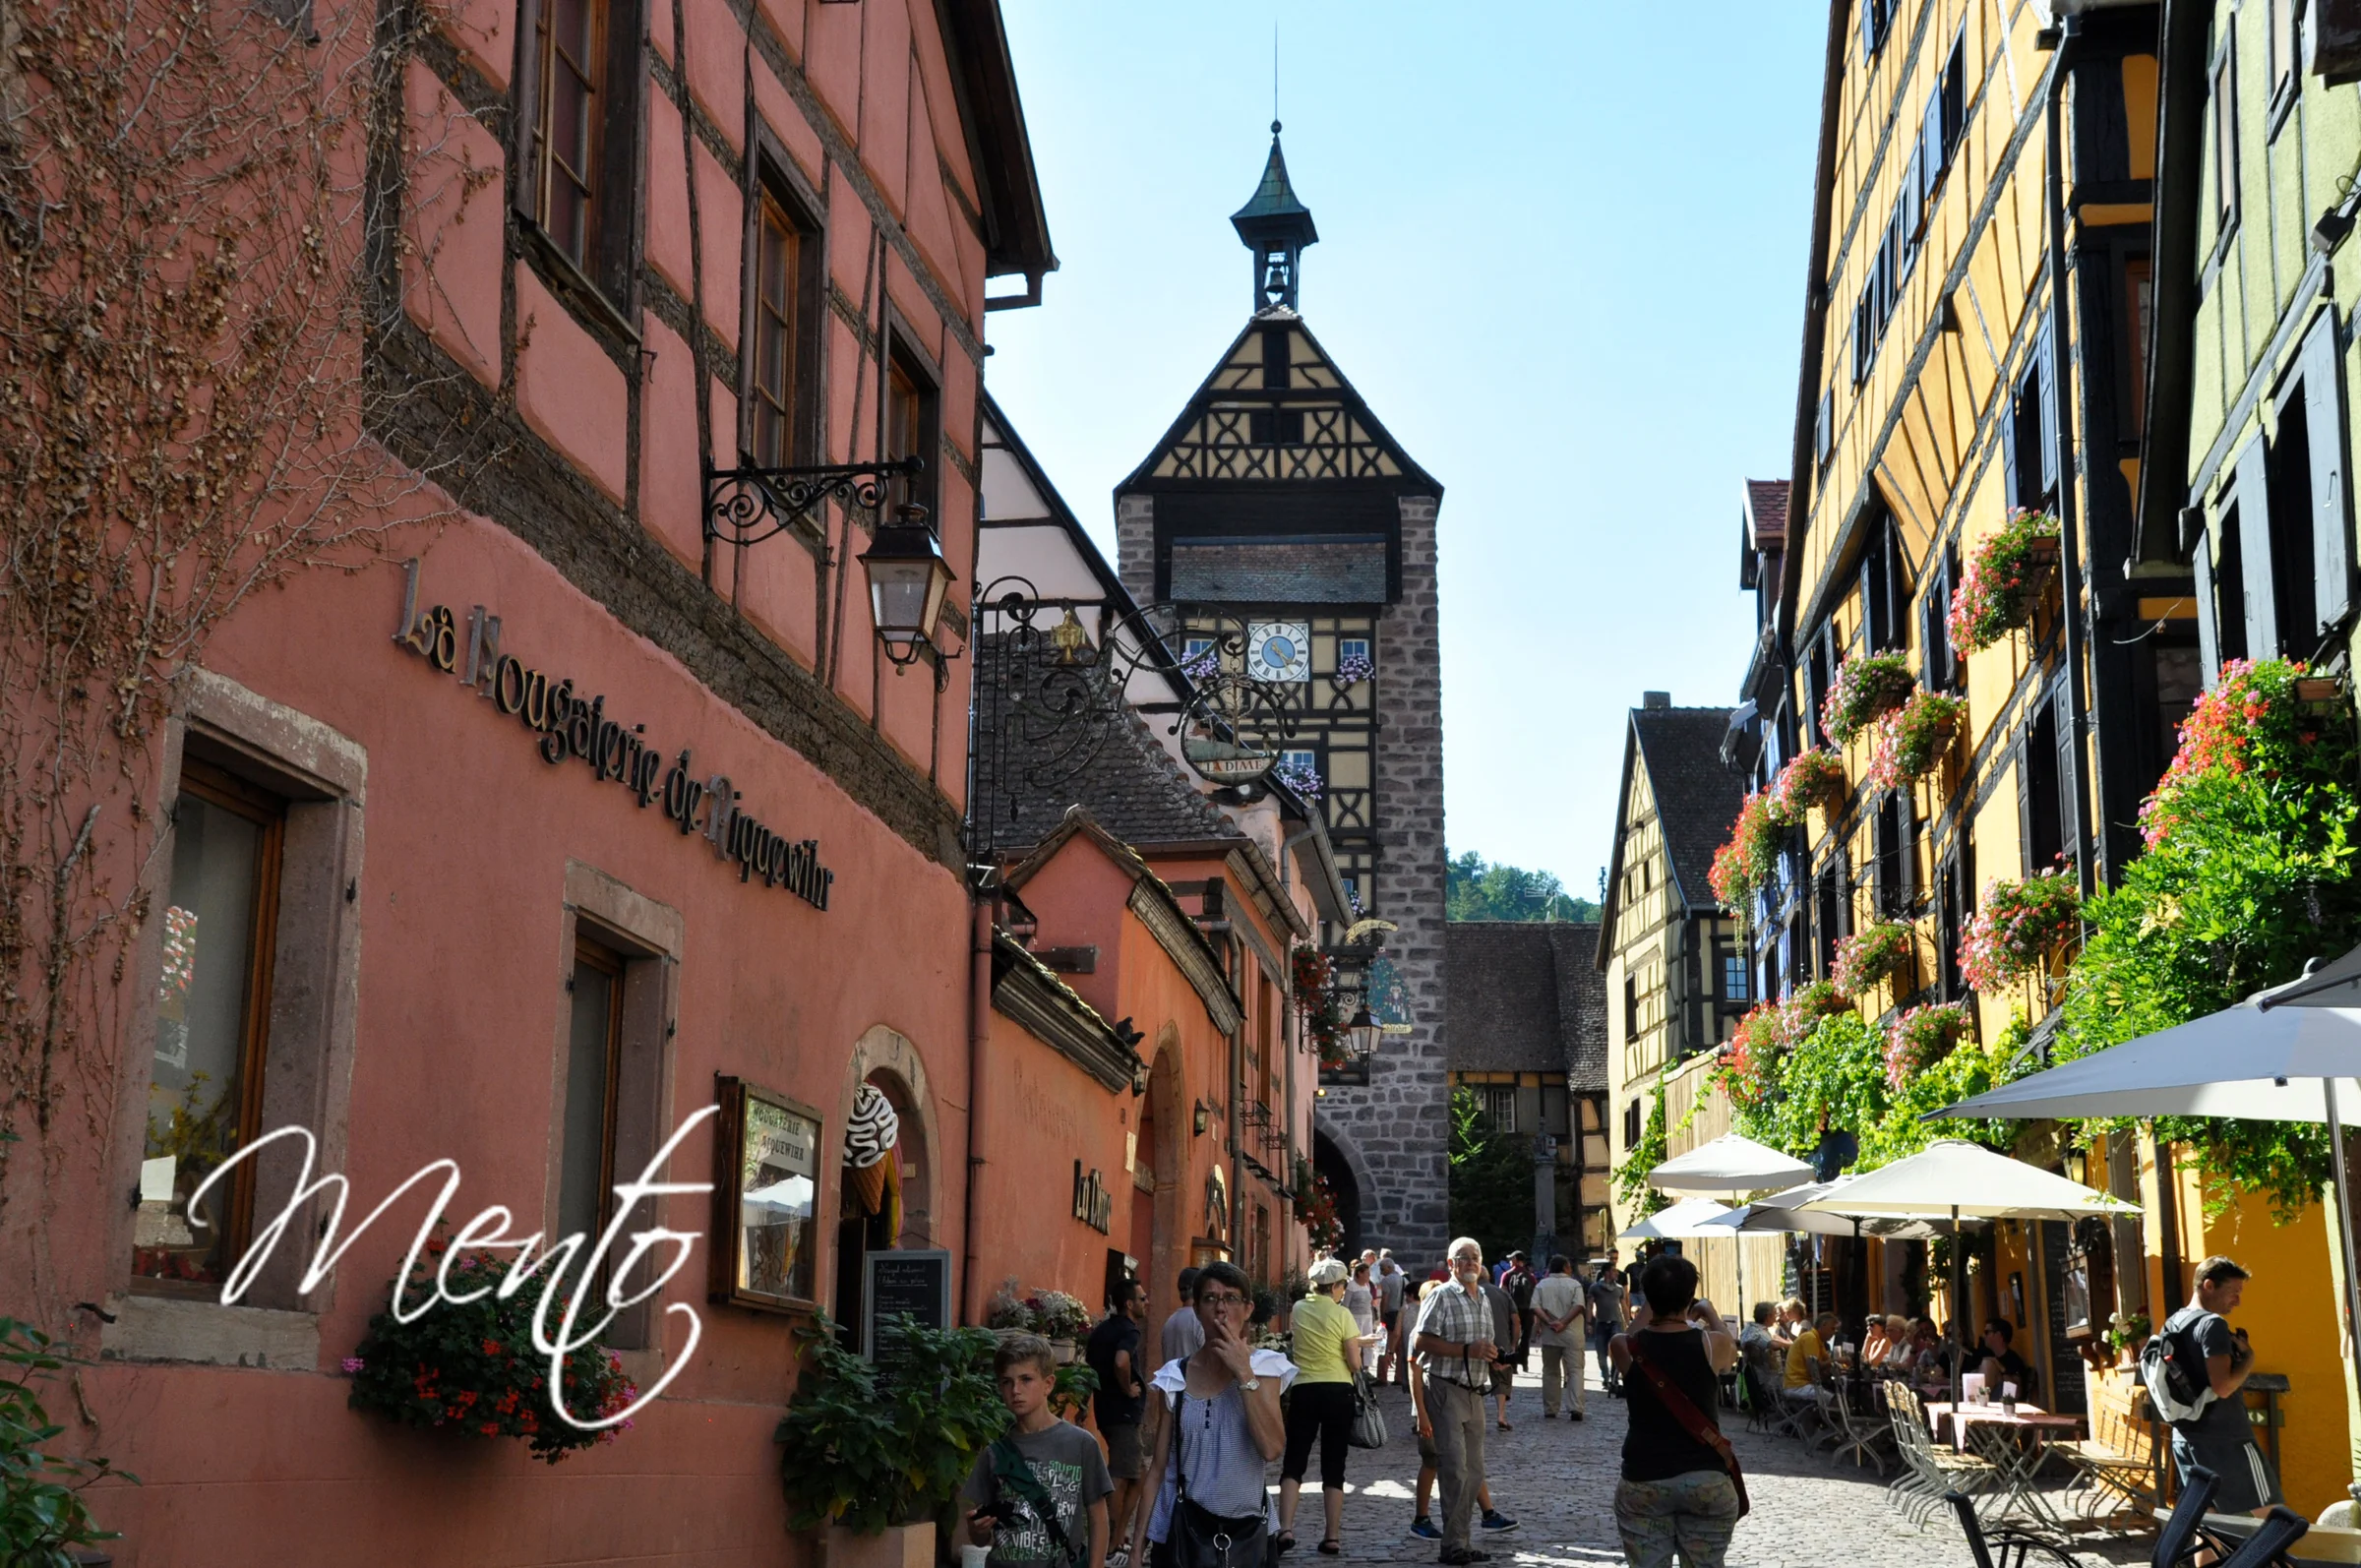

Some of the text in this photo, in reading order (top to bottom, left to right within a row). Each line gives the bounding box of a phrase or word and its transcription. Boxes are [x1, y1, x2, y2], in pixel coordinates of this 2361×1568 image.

[393, 556, 834, 912] La Nougaterie de Riquewihr
[1225, 758, 1263, 772] DIME
[1049, 1460, 1083, 1482] STUPID
